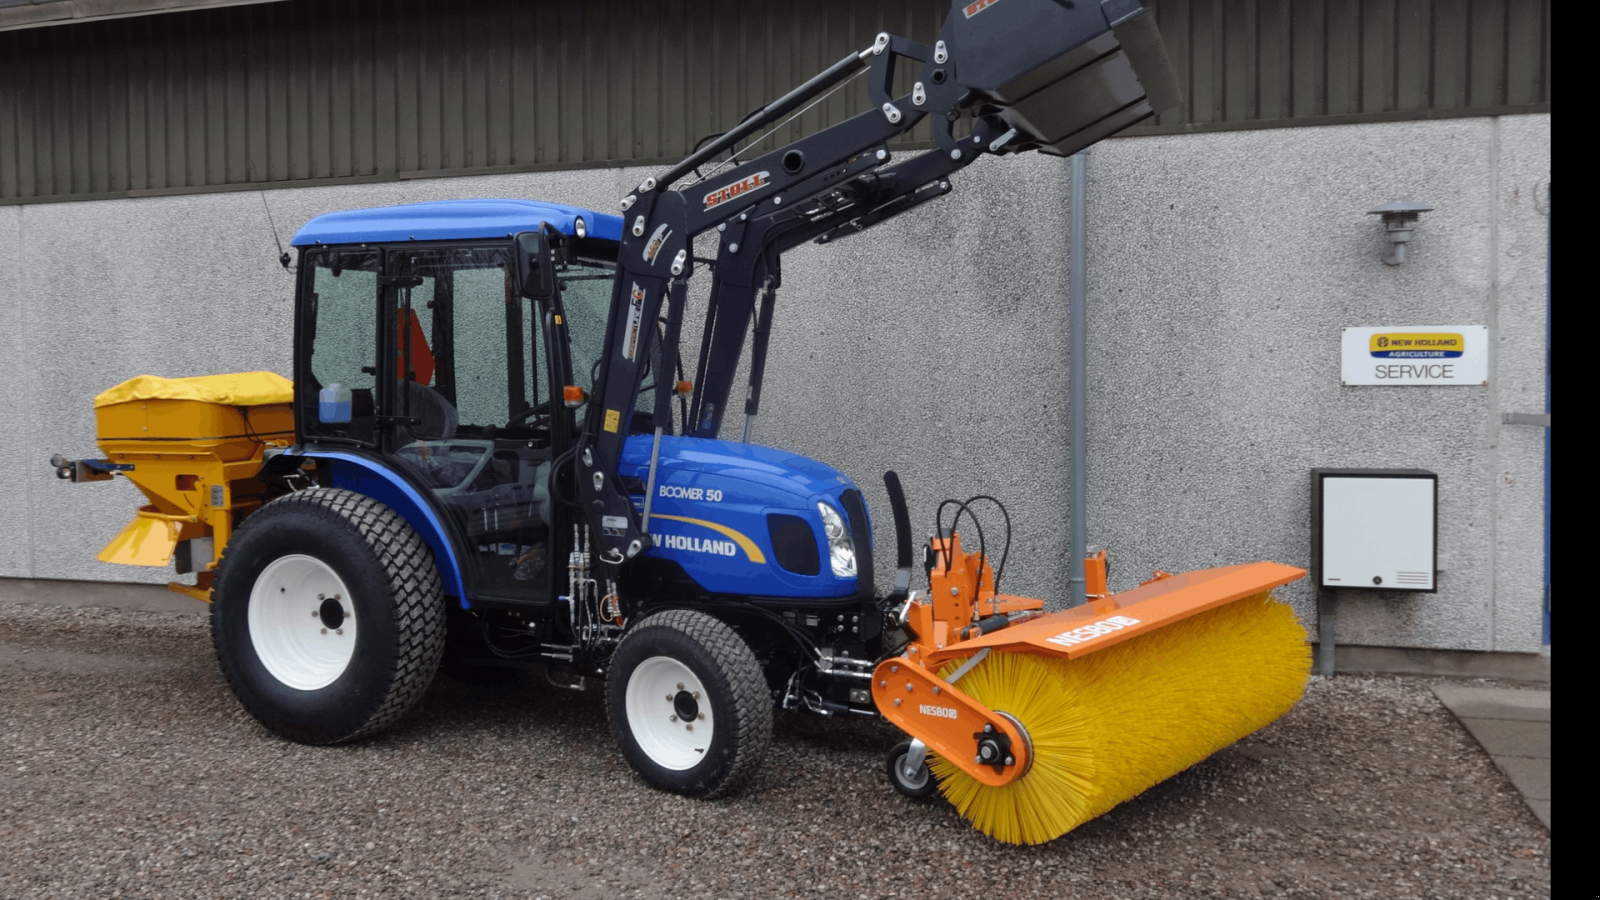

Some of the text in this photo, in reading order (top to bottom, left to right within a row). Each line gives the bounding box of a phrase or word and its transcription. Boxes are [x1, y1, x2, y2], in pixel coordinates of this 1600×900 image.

[706, 174, 765, 207] STOLL
[1374, 364, 1454, 379] SERVICE
[659, 485, 723, 502] BOOMER 50
[665, 534, 736, 557] HOLLAND
